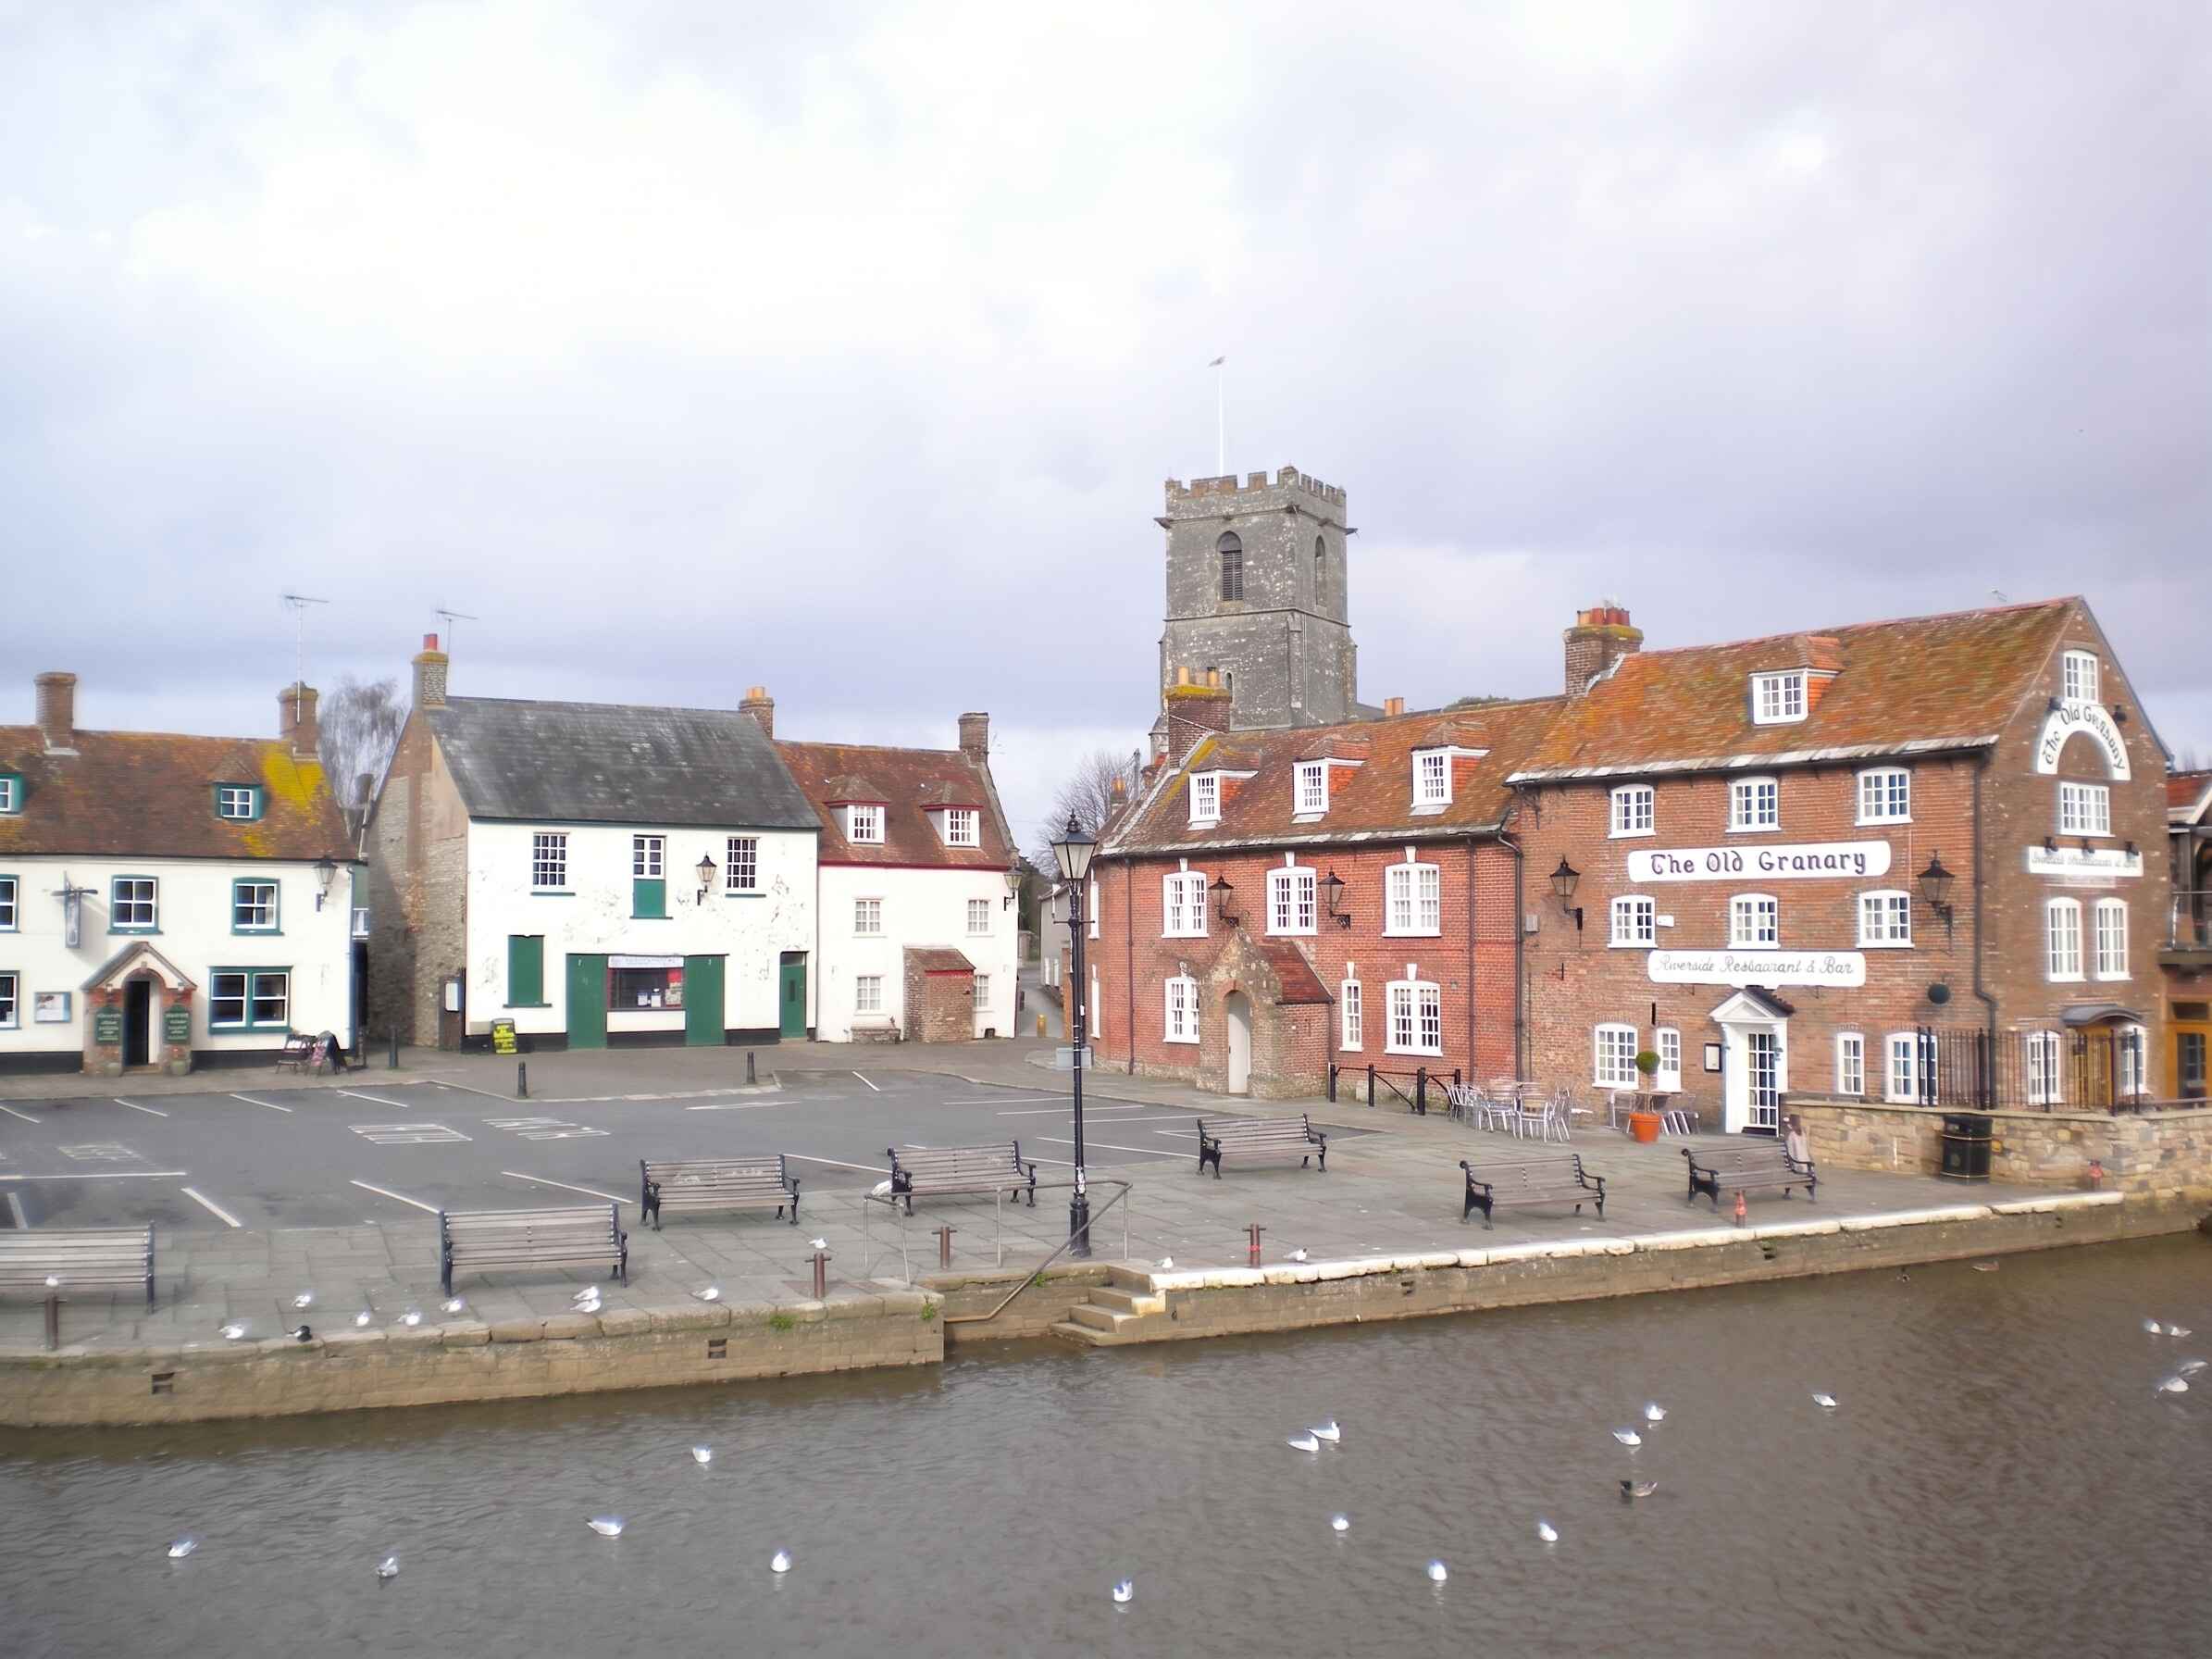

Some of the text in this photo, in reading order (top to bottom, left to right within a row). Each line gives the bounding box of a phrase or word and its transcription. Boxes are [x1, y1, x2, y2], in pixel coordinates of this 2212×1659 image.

[2060, 704, 2081, 725] Old
[1650, 850, 1866, 875] The Old Granary
[1657, 954, 1715, 972] Riverside
[1720, 954, 1802, 974] Restaurant
[1819, 955, 1854, 974] Bar
